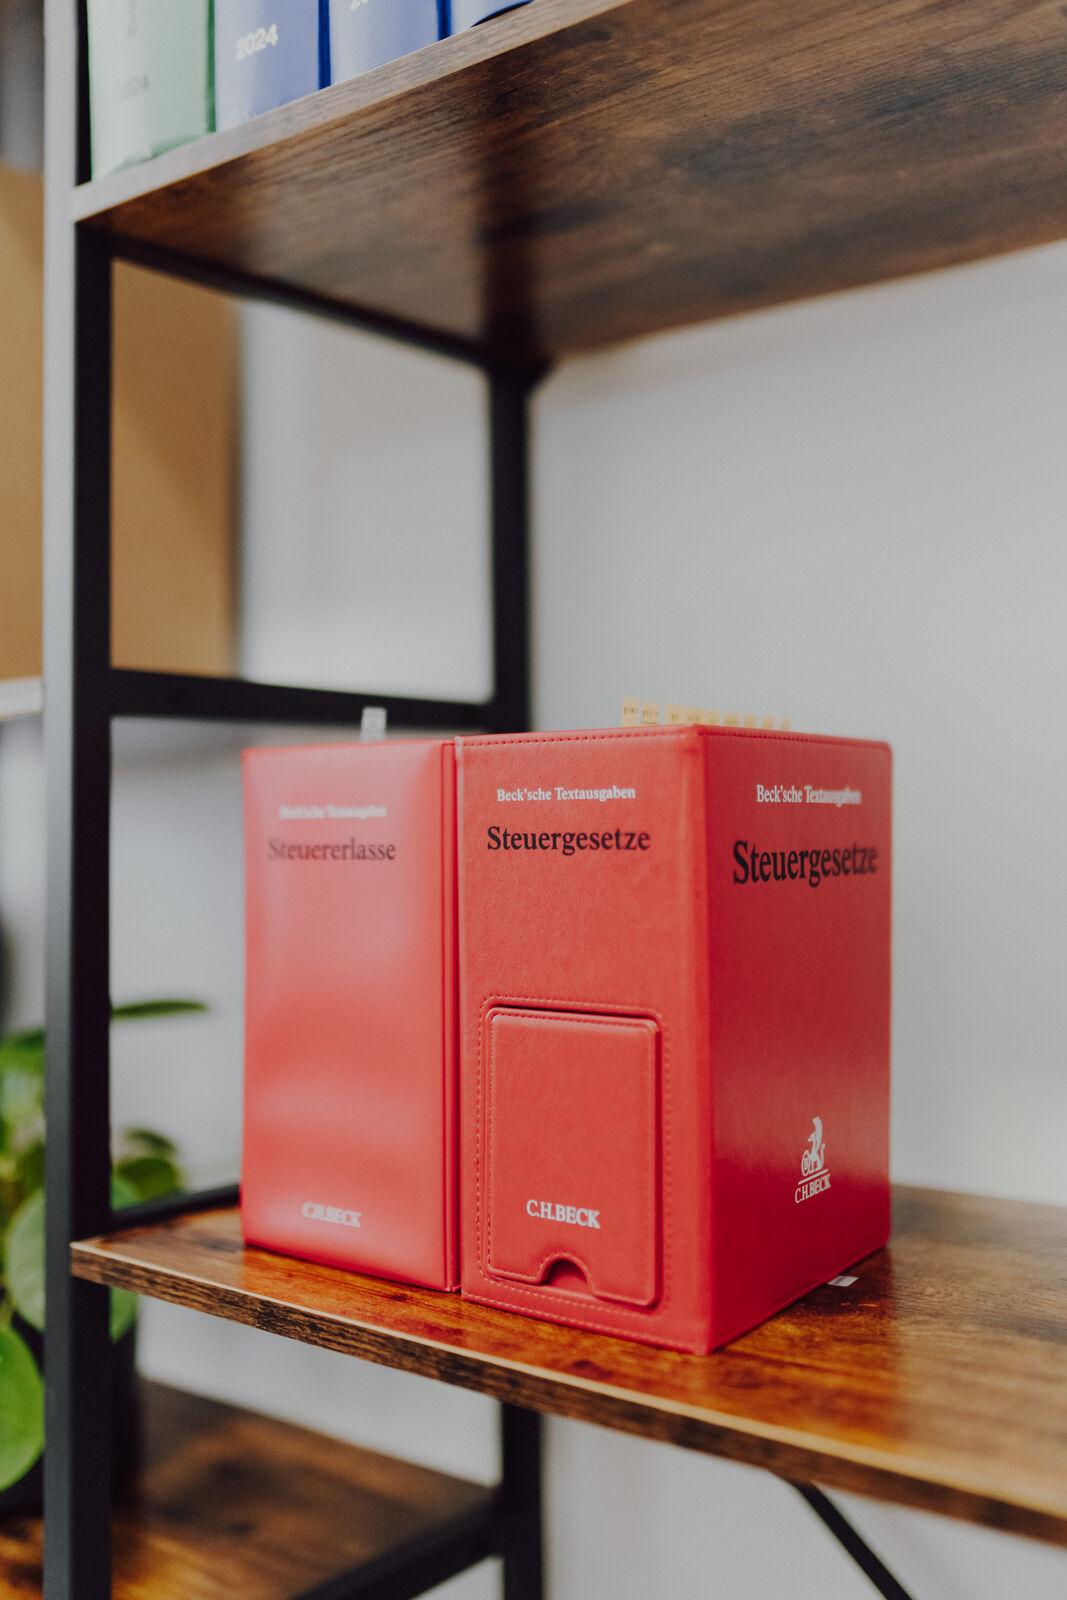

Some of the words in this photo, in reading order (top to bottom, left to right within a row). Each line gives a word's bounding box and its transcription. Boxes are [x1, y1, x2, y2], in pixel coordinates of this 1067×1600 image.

[235, 23, 279, 61] 2024
[554, 786, 636, 802] Textausgaben
[756, 784, 803, 803] Beck'sche
[267, 837, 396, 861] Steuererlasse
[487, 825, 651, 856] Steuergesetze
[733, 840, 878, 888] Steuergesetze
[526, 1199, 600, 1229] C.H.BECK
